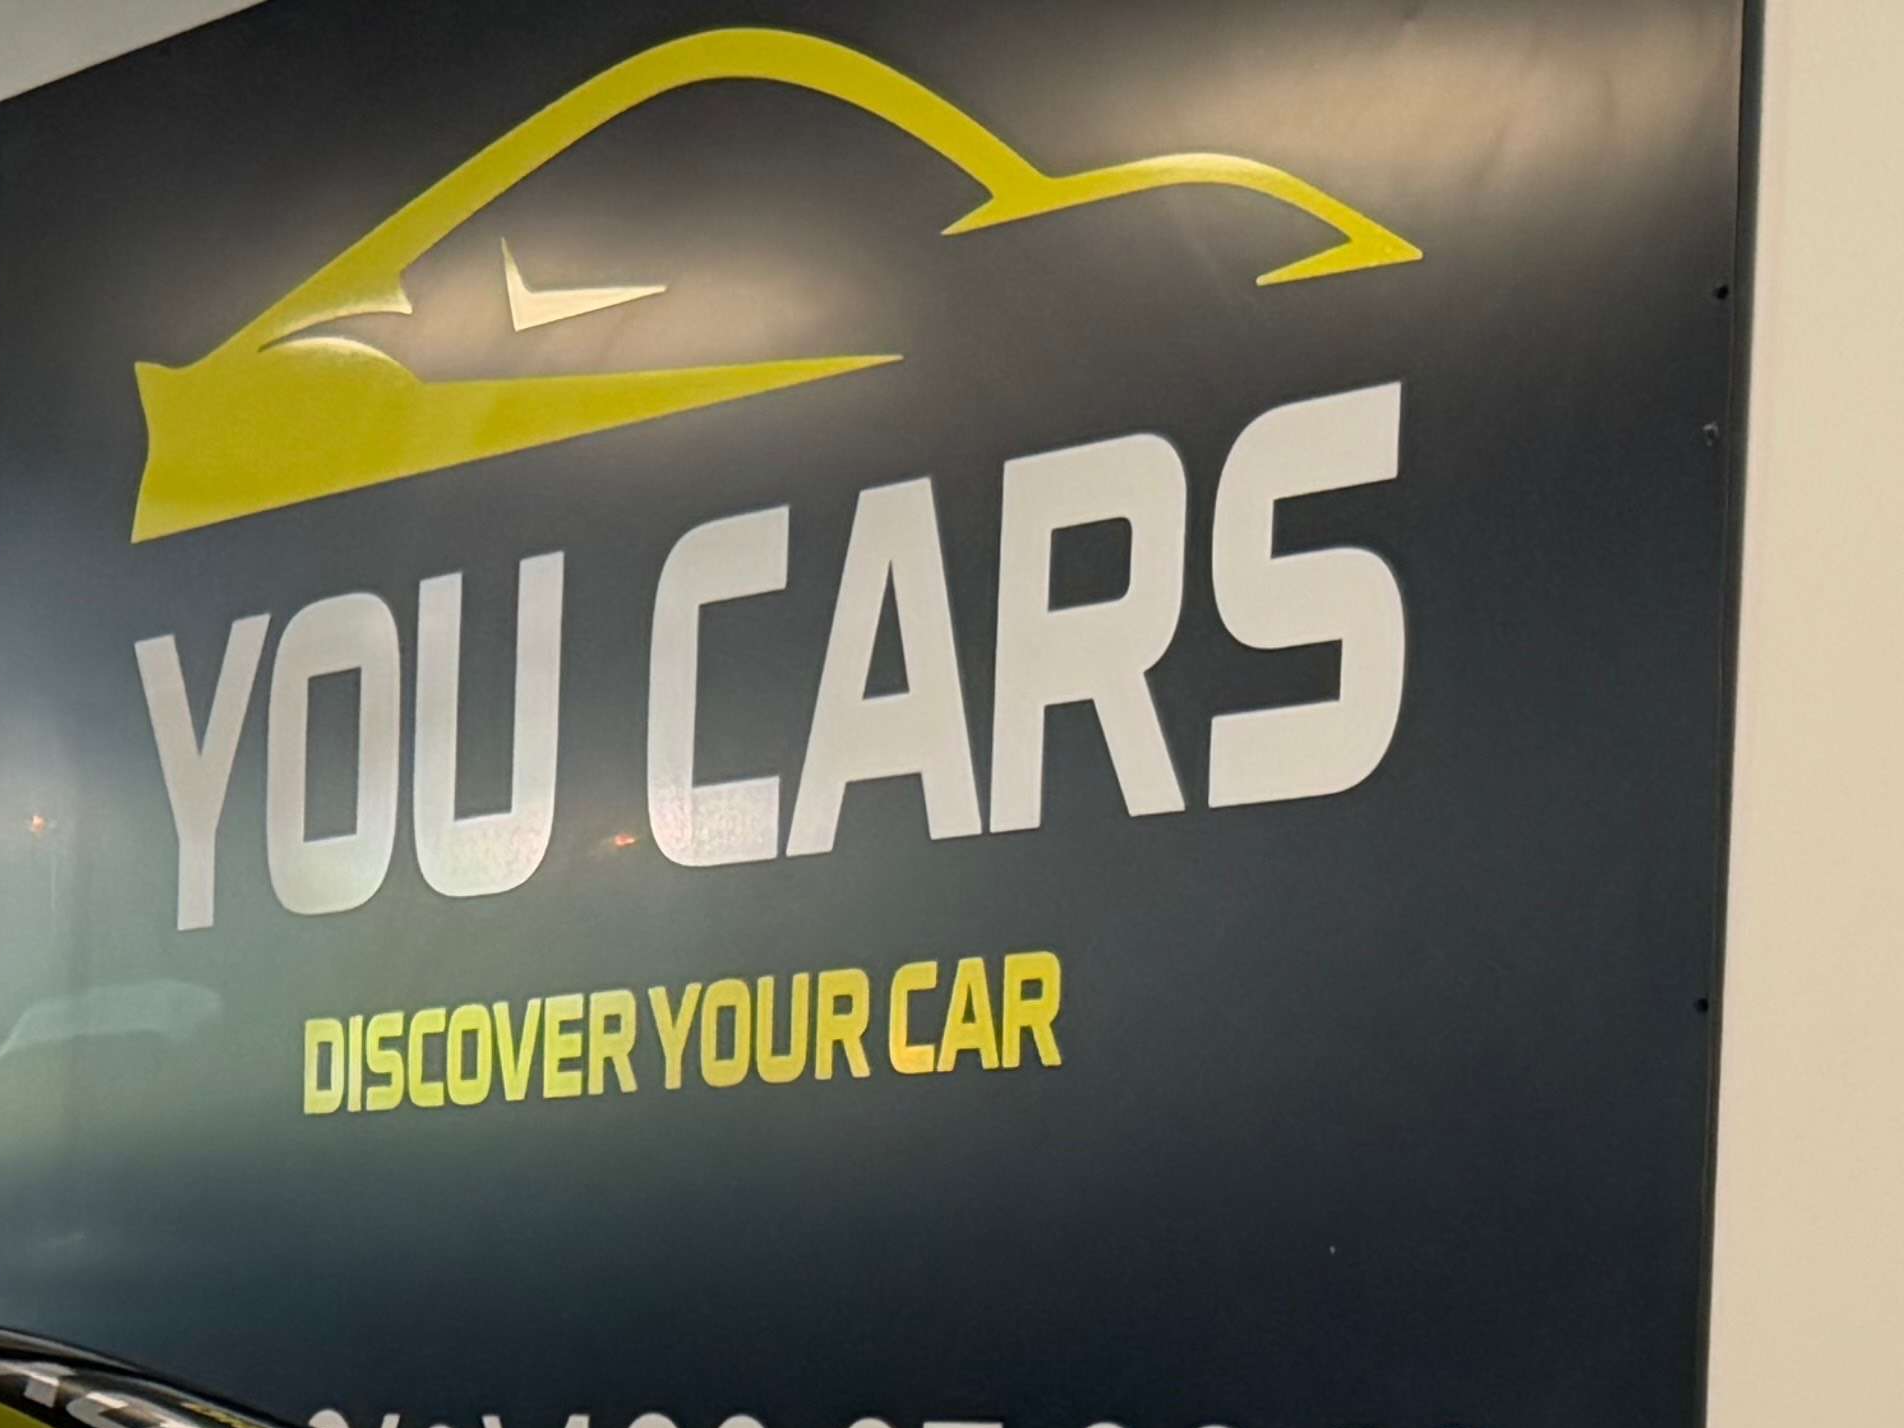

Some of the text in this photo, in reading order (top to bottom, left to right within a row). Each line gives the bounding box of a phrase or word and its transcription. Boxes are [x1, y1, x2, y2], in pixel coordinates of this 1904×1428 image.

[133, 380, 1405, 932] YOU CARS
[303, 950, 1062, 1114] DISCOVER YOUR CAR
